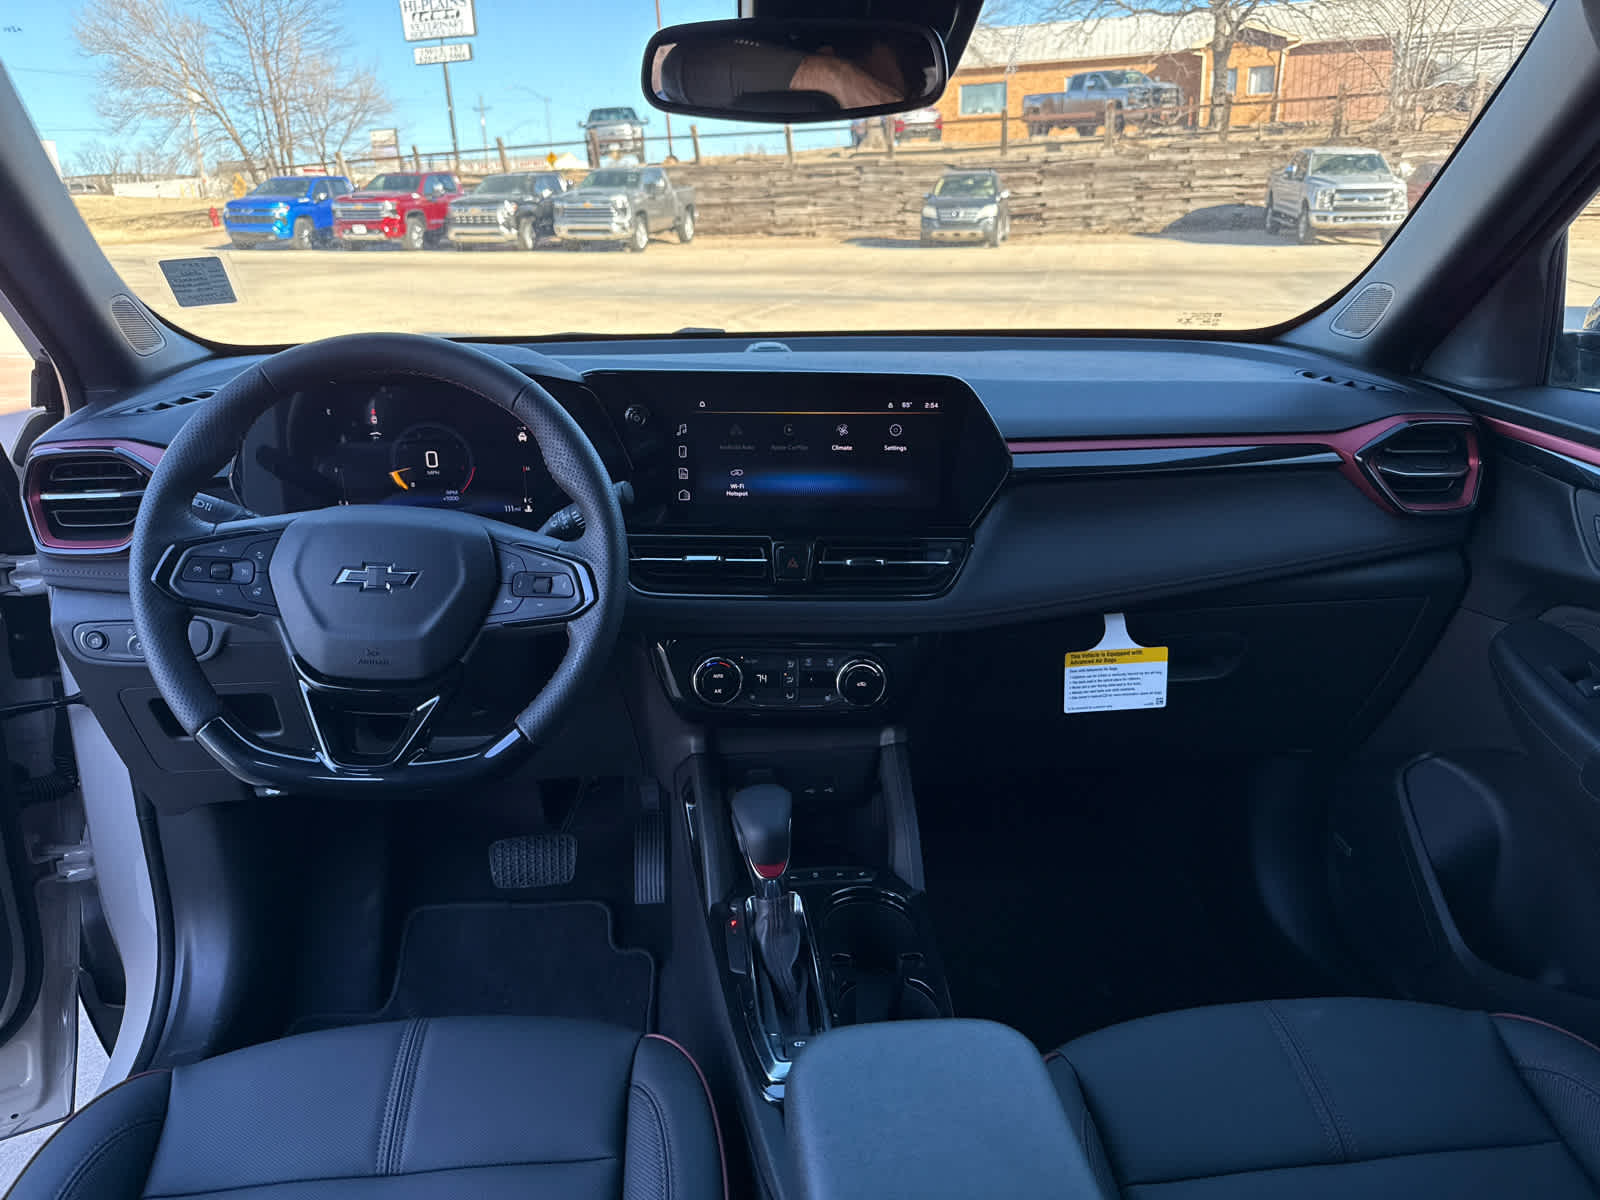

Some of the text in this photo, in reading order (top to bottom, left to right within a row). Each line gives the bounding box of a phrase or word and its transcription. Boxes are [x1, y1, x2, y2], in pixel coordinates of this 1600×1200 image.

[883, 444, 907, 453] Settings
[425, 450, 439, 468] 0
[729, 482, 745, 490] Wi-Fi
[726, 489, 749, 497] Hotspot
[755, 673, 768, 684] 74
